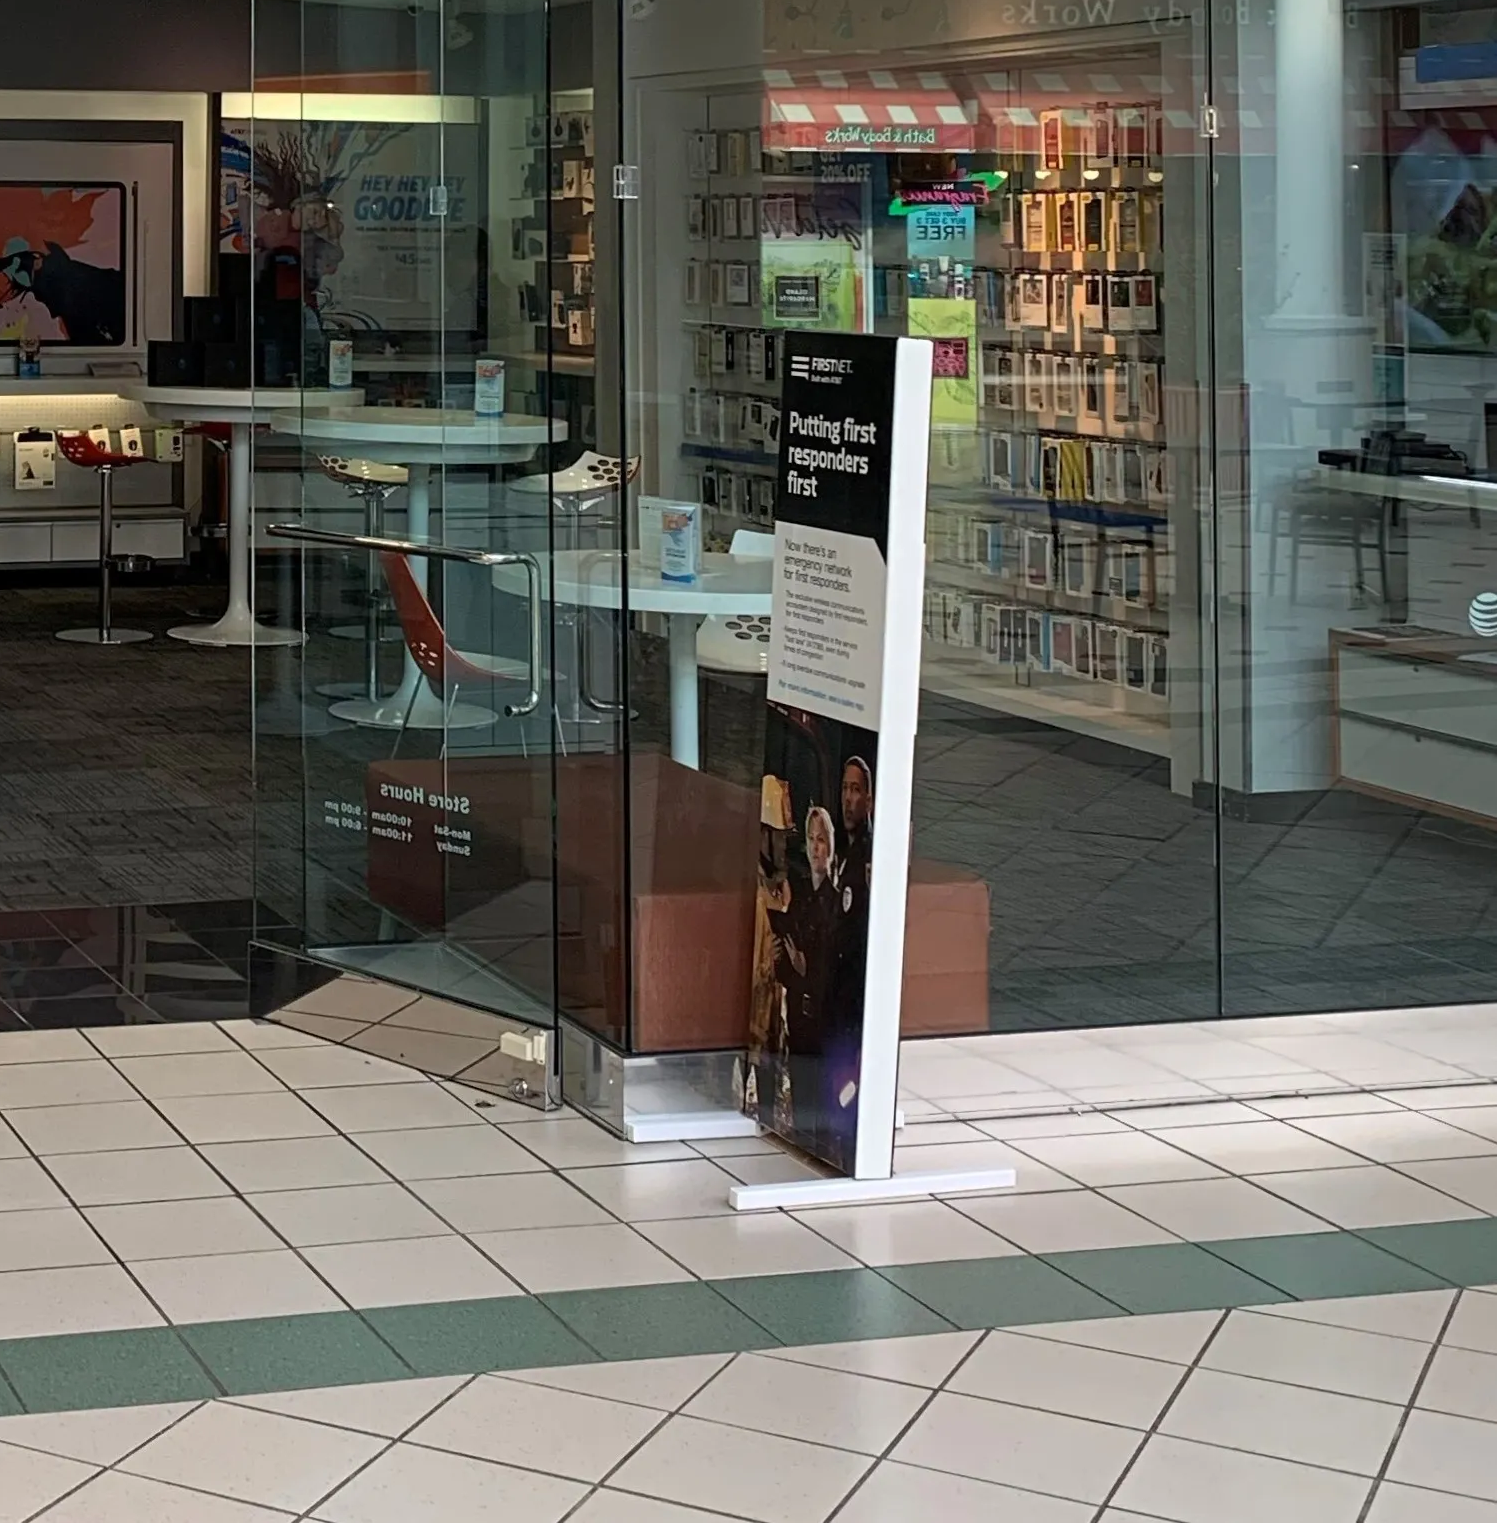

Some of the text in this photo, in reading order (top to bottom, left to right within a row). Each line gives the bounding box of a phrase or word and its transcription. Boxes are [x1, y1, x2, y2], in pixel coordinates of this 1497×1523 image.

[360, 174, 394, 192] HEY
[397, 175, 431, 192] HEY
[847, 163, 873, 183] OFF
[354, 195, 466, 222] GOODE
[788, 410, 876, 445] Putting first
[788, 445, 869, 475] responders
[787, 470, 818, 498] first
[784, 538, 837, 560] Now there's an
[784, 555, 853, 579] emergency network
[784, 567, 851, 593] for first responders.
